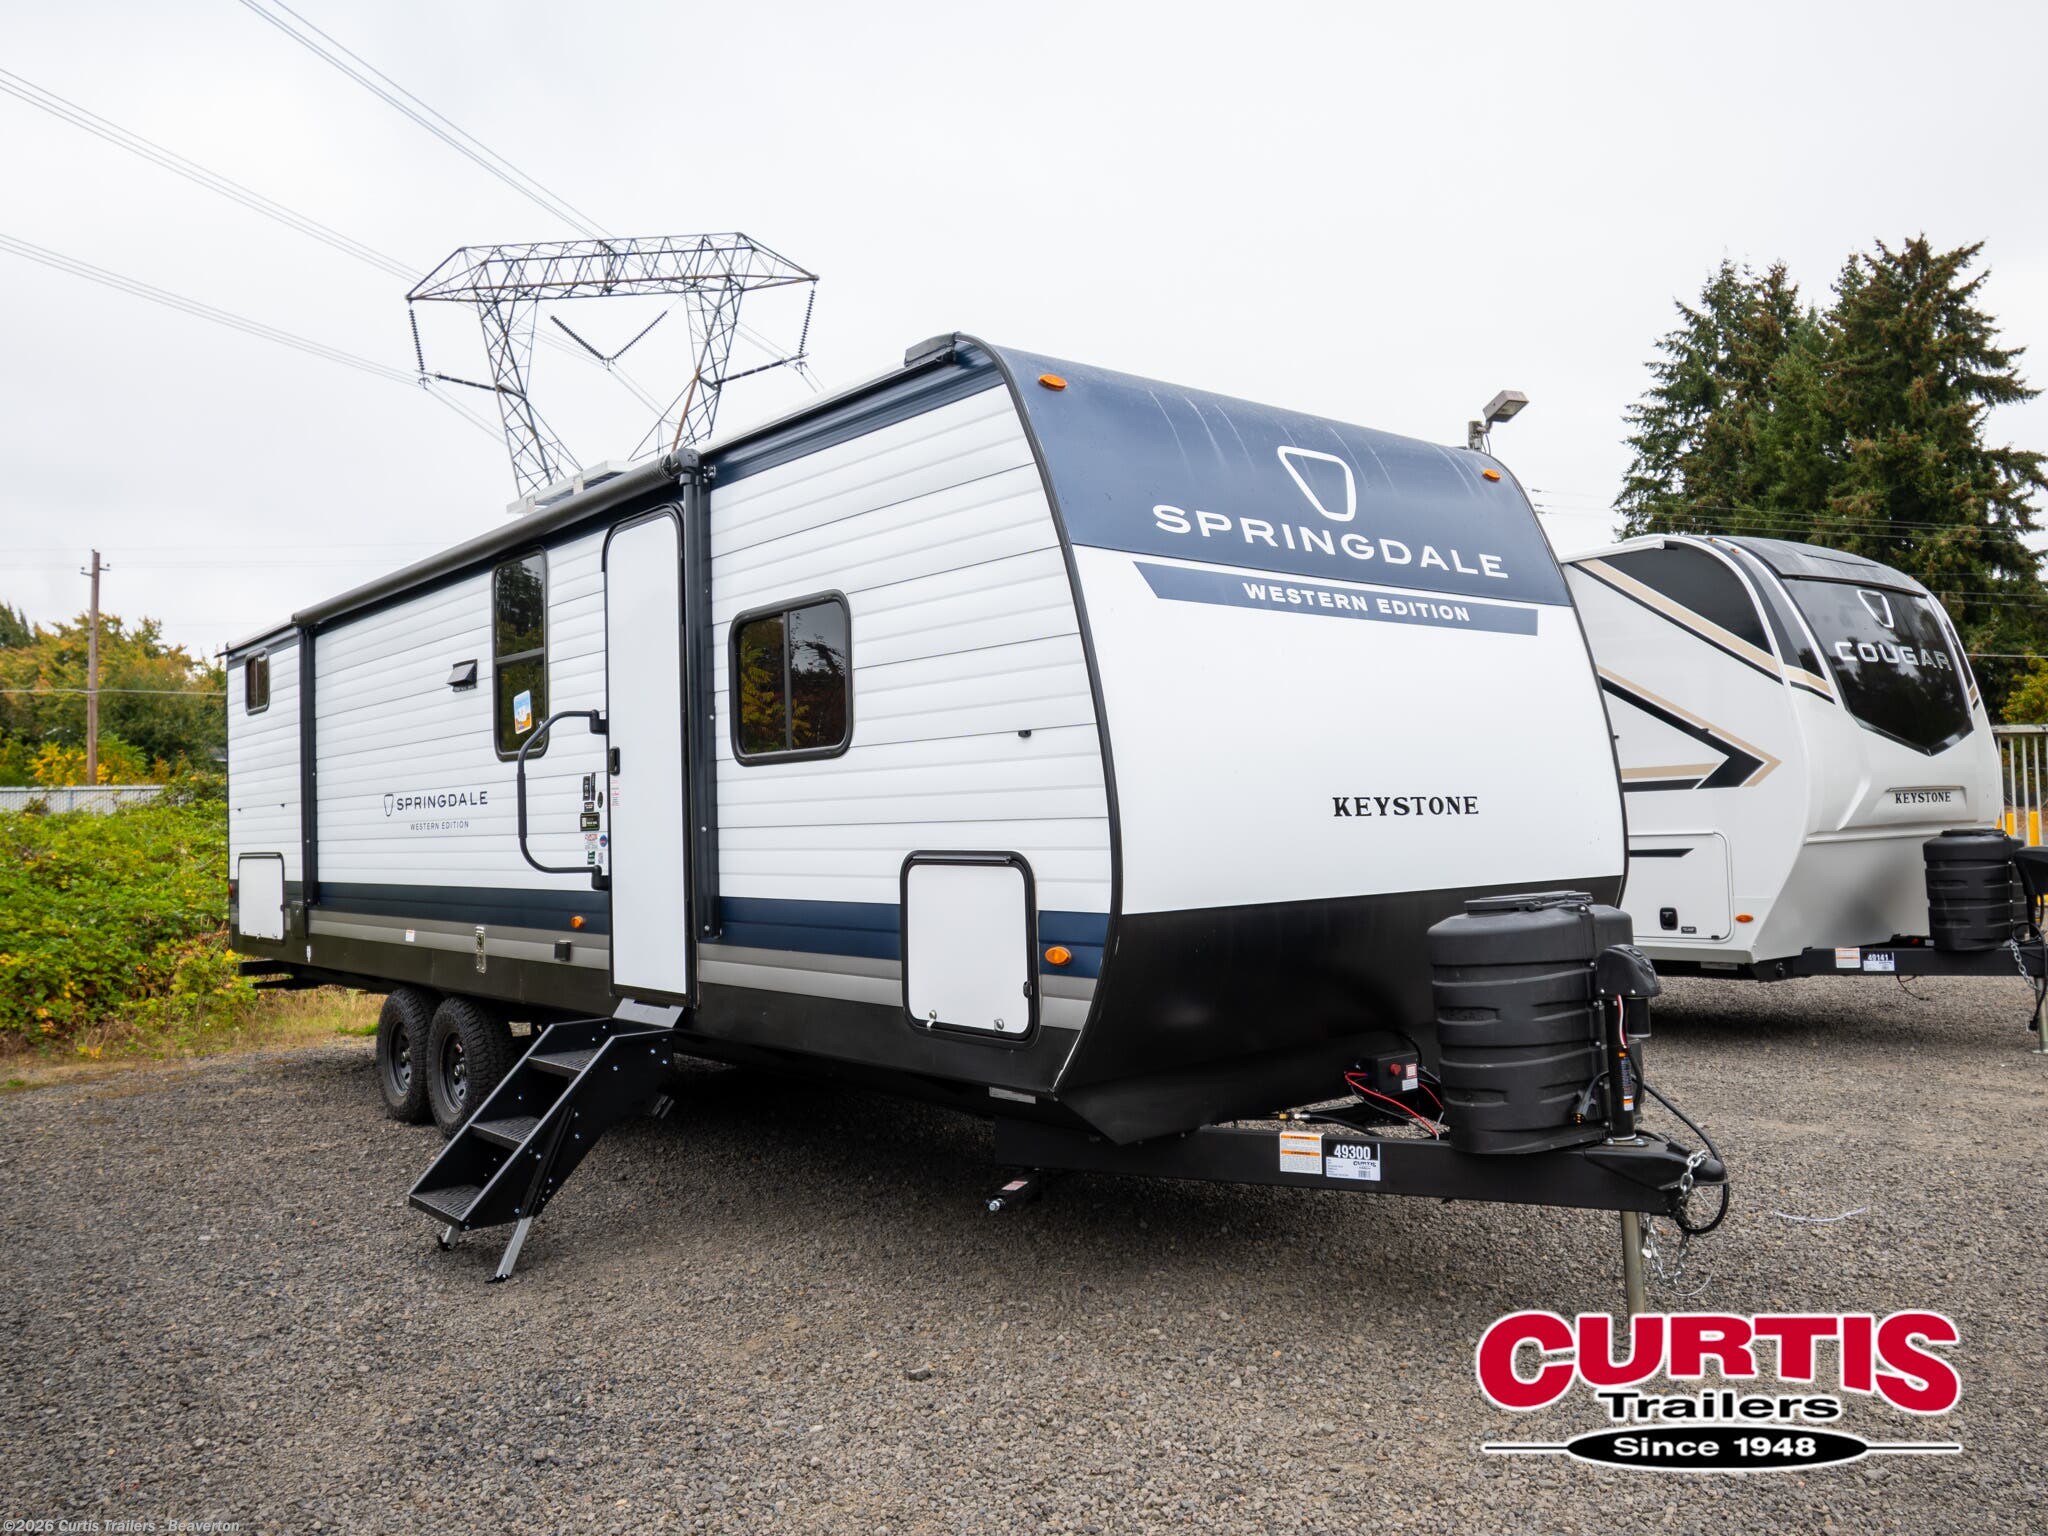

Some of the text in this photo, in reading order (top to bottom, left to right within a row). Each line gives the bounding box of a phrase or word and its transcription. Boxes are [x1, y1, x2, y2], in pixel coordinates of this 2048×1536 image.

[1152, 504, 1509, 579] SPRINGDALE
[1242, 582, 1470, 622] WESTERN EDITION
[1834, 641, 1953, 672] COUGAR
[396, 791, 488, 811] SPRINGDALE
[1332, 796, 1480, 817] KEYSTONE
[1894, 791, 1952, 804] KEYSTONE
[410, 820, 469, 831] WESTERN EDITION
[1334, 1144, 1371, 1160] 49300
